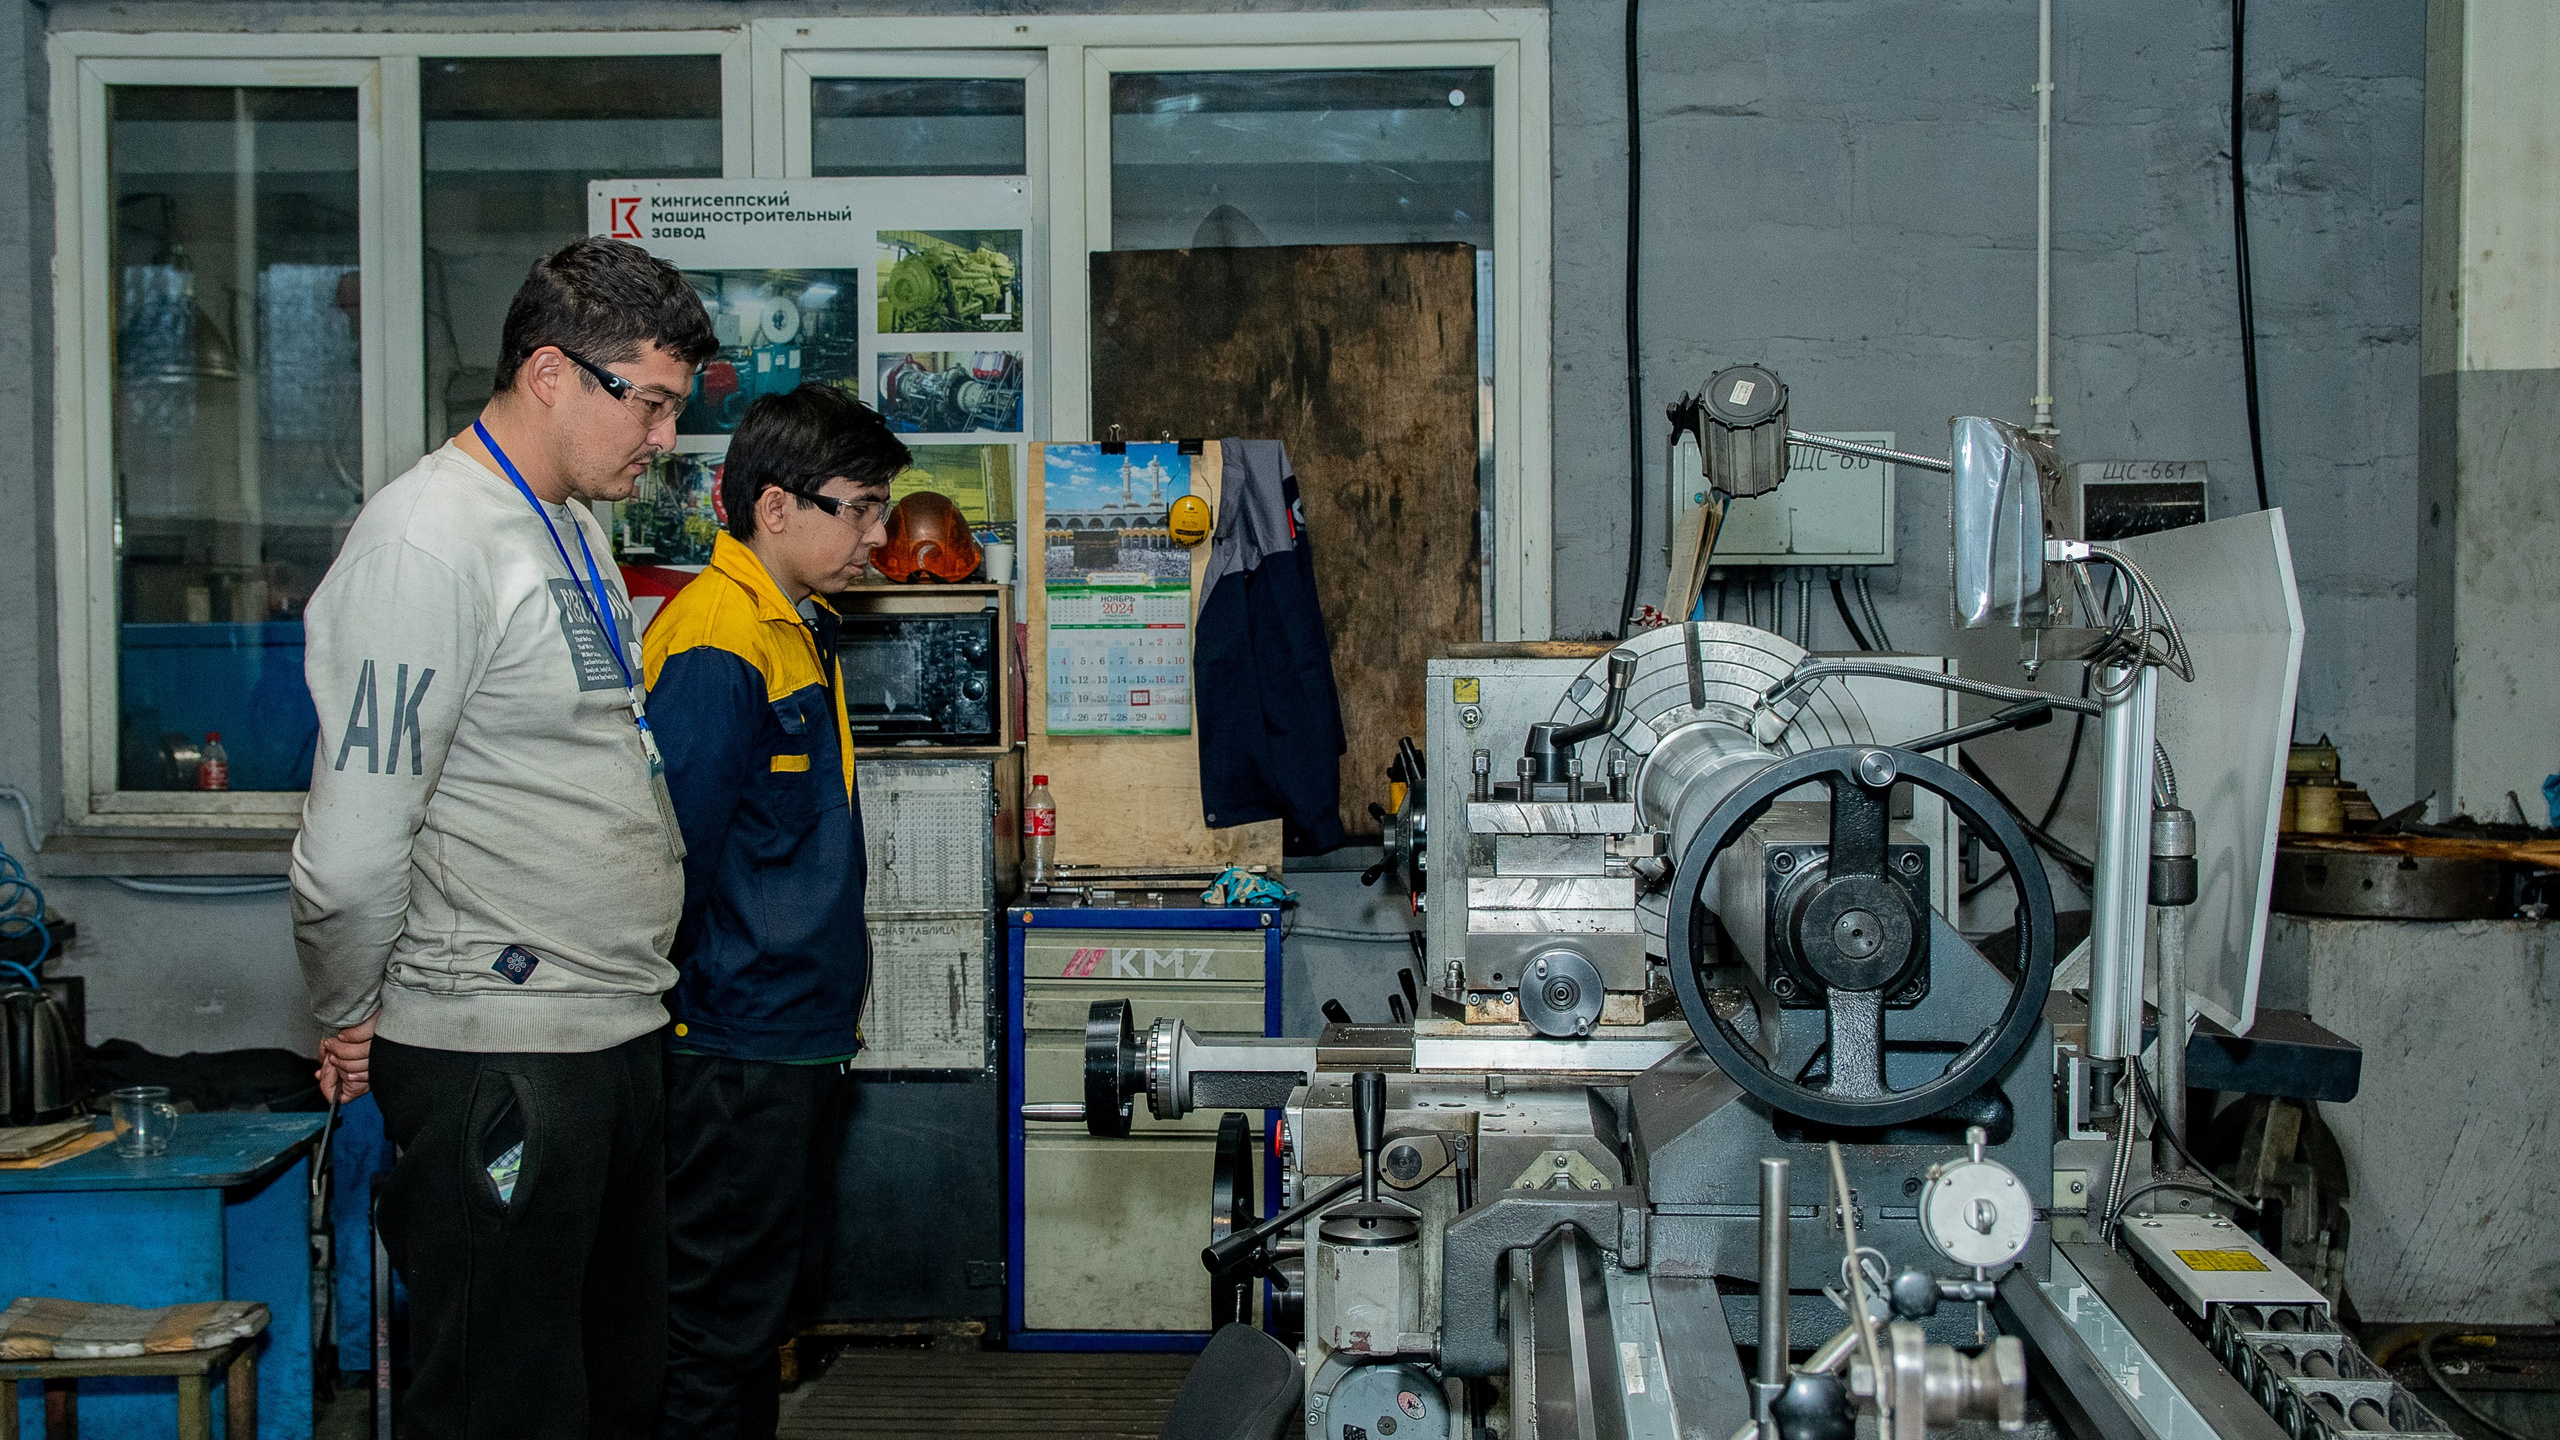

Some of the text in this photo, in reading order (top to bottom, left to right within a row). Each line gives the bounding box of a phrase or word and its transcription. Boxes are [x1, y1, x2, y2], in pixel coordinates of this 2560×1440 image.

[651, 190, 790, 208] кингисеппский
[651, 205, 852, 225] машиностроительный
[651, 225, 706, 240] завод
[1100, 595, 1136, 603] НОЯБРЬ
[1102, 602, 1135, 614] 2024
[1139, 638, 1143, 646] 1
[1157, 638, 1163, 646] 2
[1176, 638, 1182, 646] 3
[1060, 657, 1185, 665] 4 5 6 7 8 9 10
[1059, 676, 1185, 684] 11 12 13 14 15 16 17
[1059, 695, 1069, 703] 18
[1078, 695, 1089, 703] 19
[1096, 695, 1108, 703] 20
[1116, 694, 1126, 703] 21
[1136, 694, 1146, 702] 22
[334, 659, 436, 776] AK
[1078, 714, 1089, 722] 26
[1097, 714, 1108, 722] 27
[1116, 713, 1128, 722] 28
[1136, 713, 1147, 722] 29
[1155, 713, 1166, 722] 30
[908, 926, 956, 936] ТАБЛИЦА
[1111, 948, 1217, 979] KMZ
